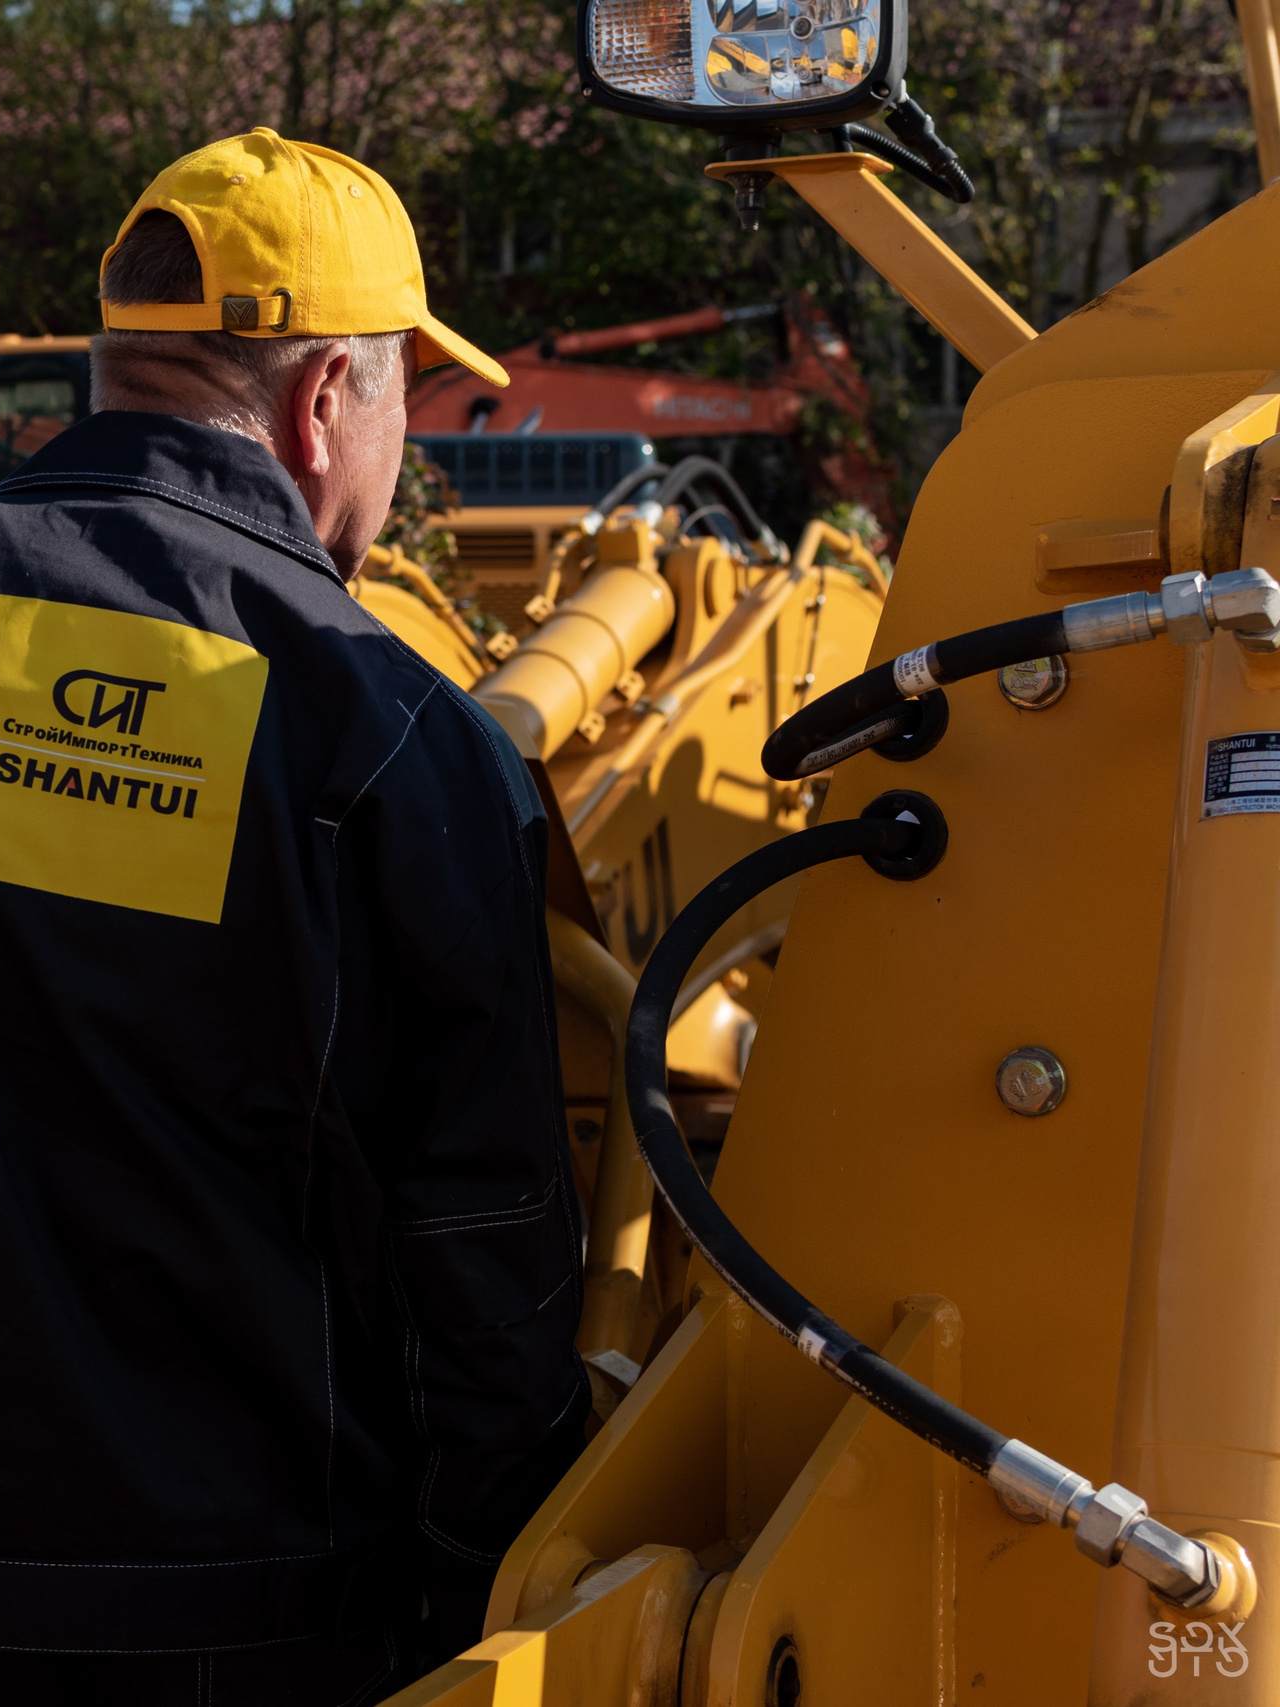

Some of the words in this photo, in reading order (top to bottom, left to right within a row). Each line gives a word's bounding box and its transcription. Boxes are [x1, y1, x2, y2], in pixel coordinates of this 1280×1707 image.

[52, 669, 167, 736] СИТ
[3, 717, 203, 770] СтройИмпортТехника
[1218, 738, 1256, 752] SHANTUI
